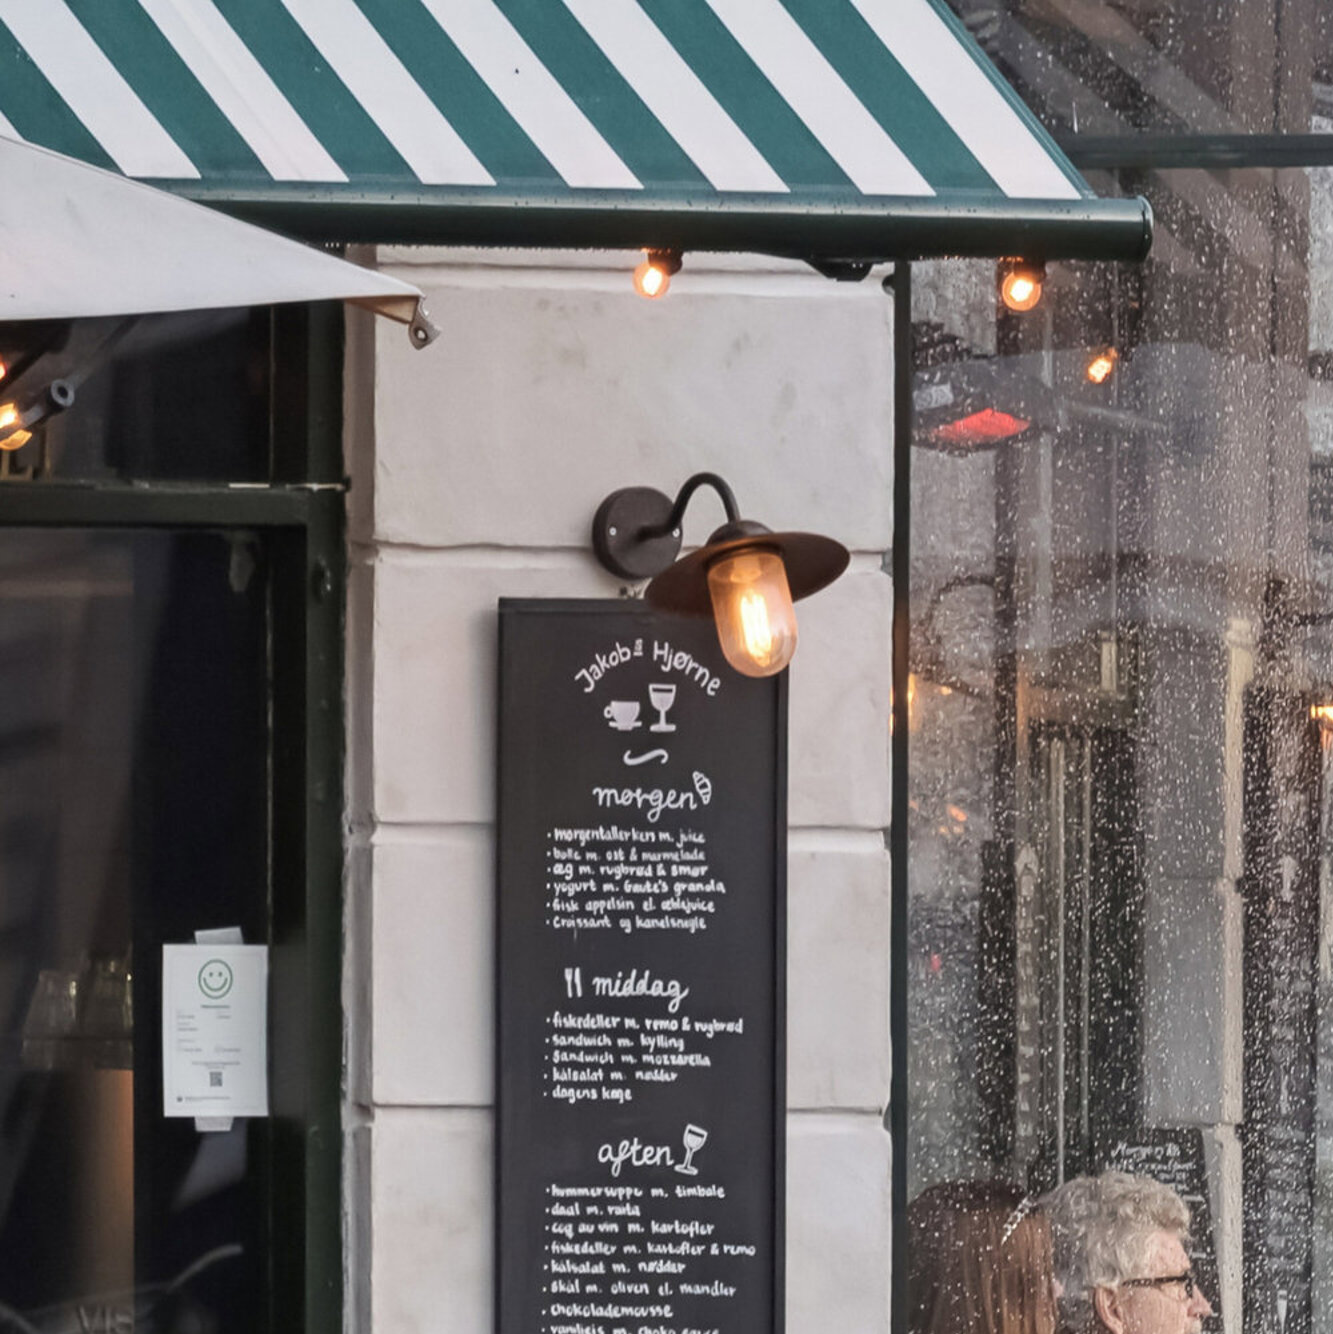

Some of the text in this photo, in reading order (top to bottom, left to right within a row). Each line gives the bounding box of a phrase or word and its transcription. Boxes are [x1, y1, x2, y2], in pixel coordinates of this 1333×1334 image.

[653, 639, 722, 696] Hjørne
[592, 786, 698, 823] morgen
[592, 968, 690, 1014] middag
[597, 1136, 675, 1178] aften
